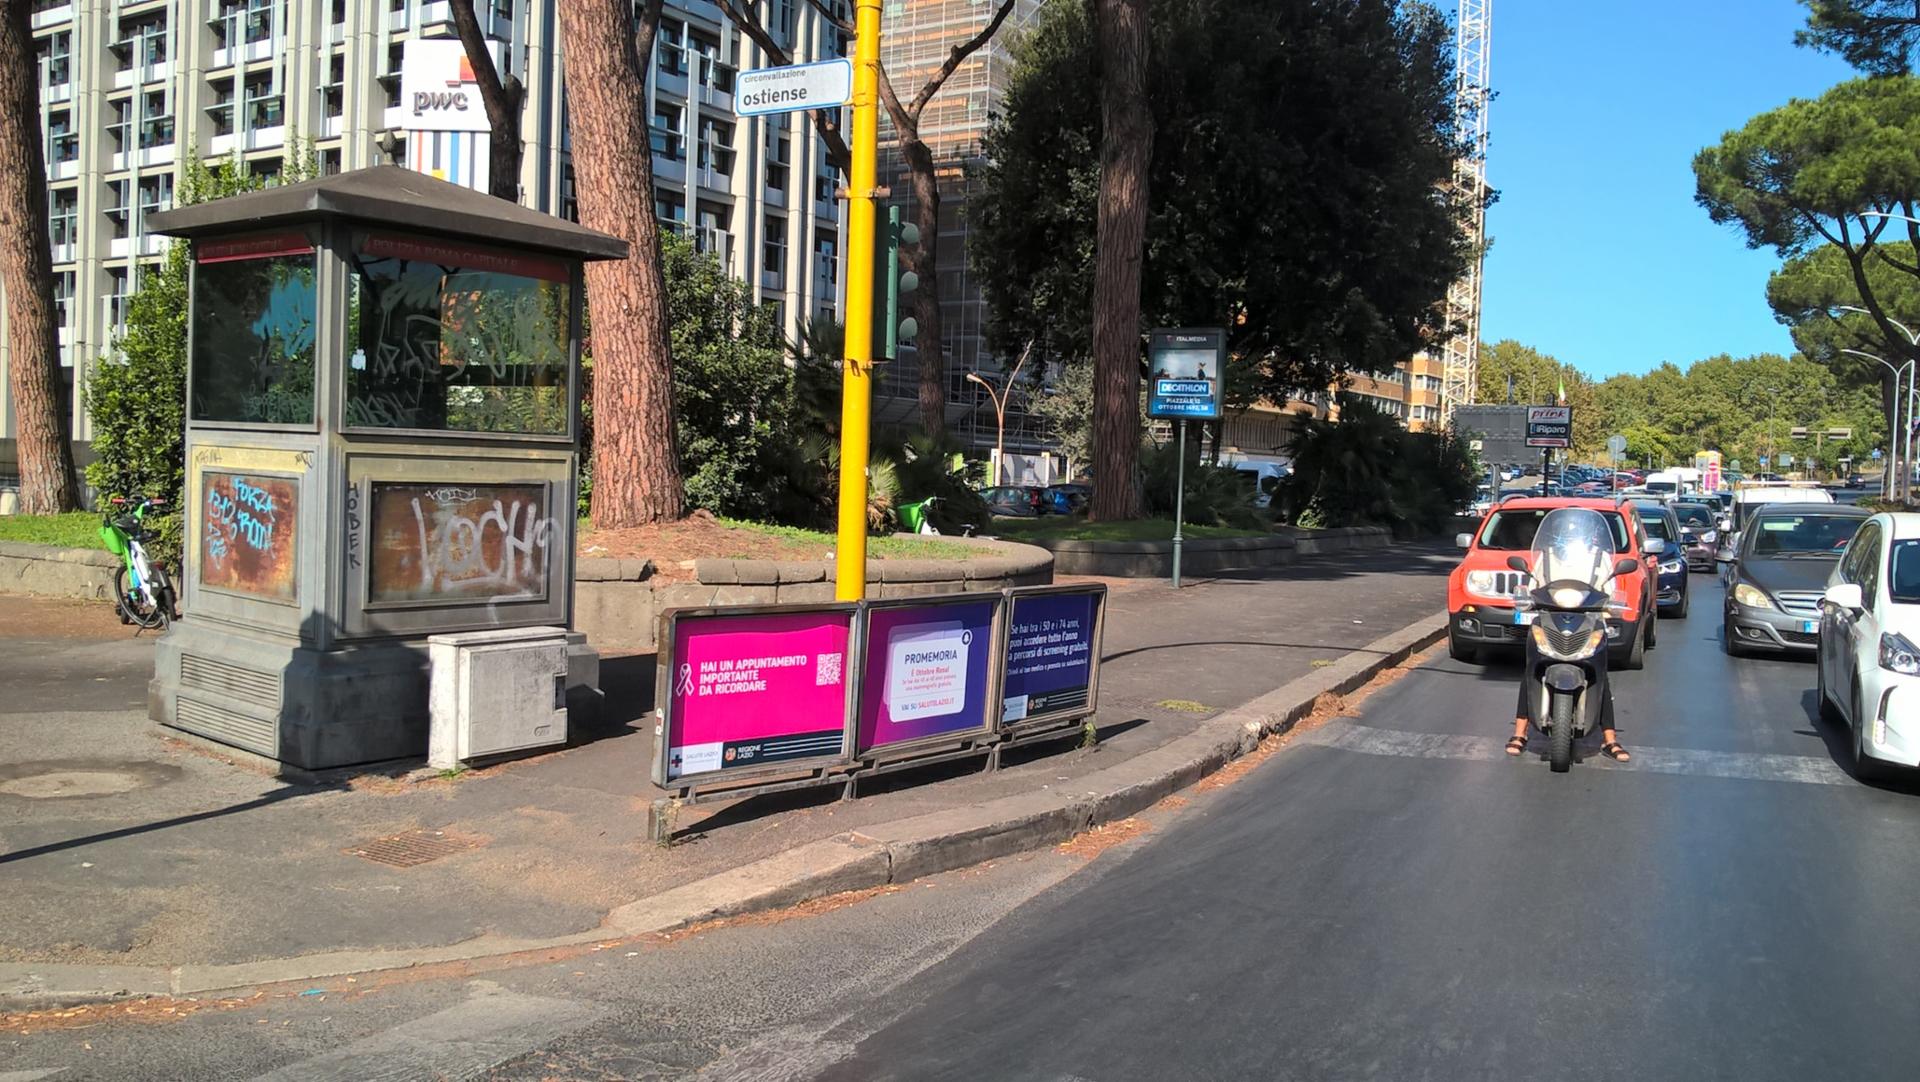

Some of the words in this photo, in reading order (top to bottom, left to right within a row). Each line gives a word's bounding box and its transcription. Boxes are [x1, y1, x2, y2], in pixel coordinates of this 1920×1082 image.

[744, 69, 806, 83] circonvallazione
[413, 91, 468, 116] pwc
[743, 87, 807, 106] ostiense
[1161, 383, 1207, 393] DECATHLON
[1011, 624, 1018, 635] Se
[1019, 623, 1029, 633] hai
[1030, 623, 1038, 633] tra
[1009, 637, 1023, 650] puoi
[1023, 634, 1047, 646] accedere
[1048, 633, 1062, 643] tutto
[905, 650, 957, 664] PROMEMORIA
[1013, 648, 1035, 662] percorsi
[1037, 646, 1042, 657] di
[1043, 645, 1068, 656] screening
[700, 661, 717, 672] HAI
[719, 659, 733, 671] UN
[735, 655, 807, 670] APPUNTAMENTO
[700, 670, 759, 684] IMPORTANTE
[699, 684, 713, 696] DA
[715, 680, 767, 694] RICORDARE
[738, 744, 761, 753] REGIONE
